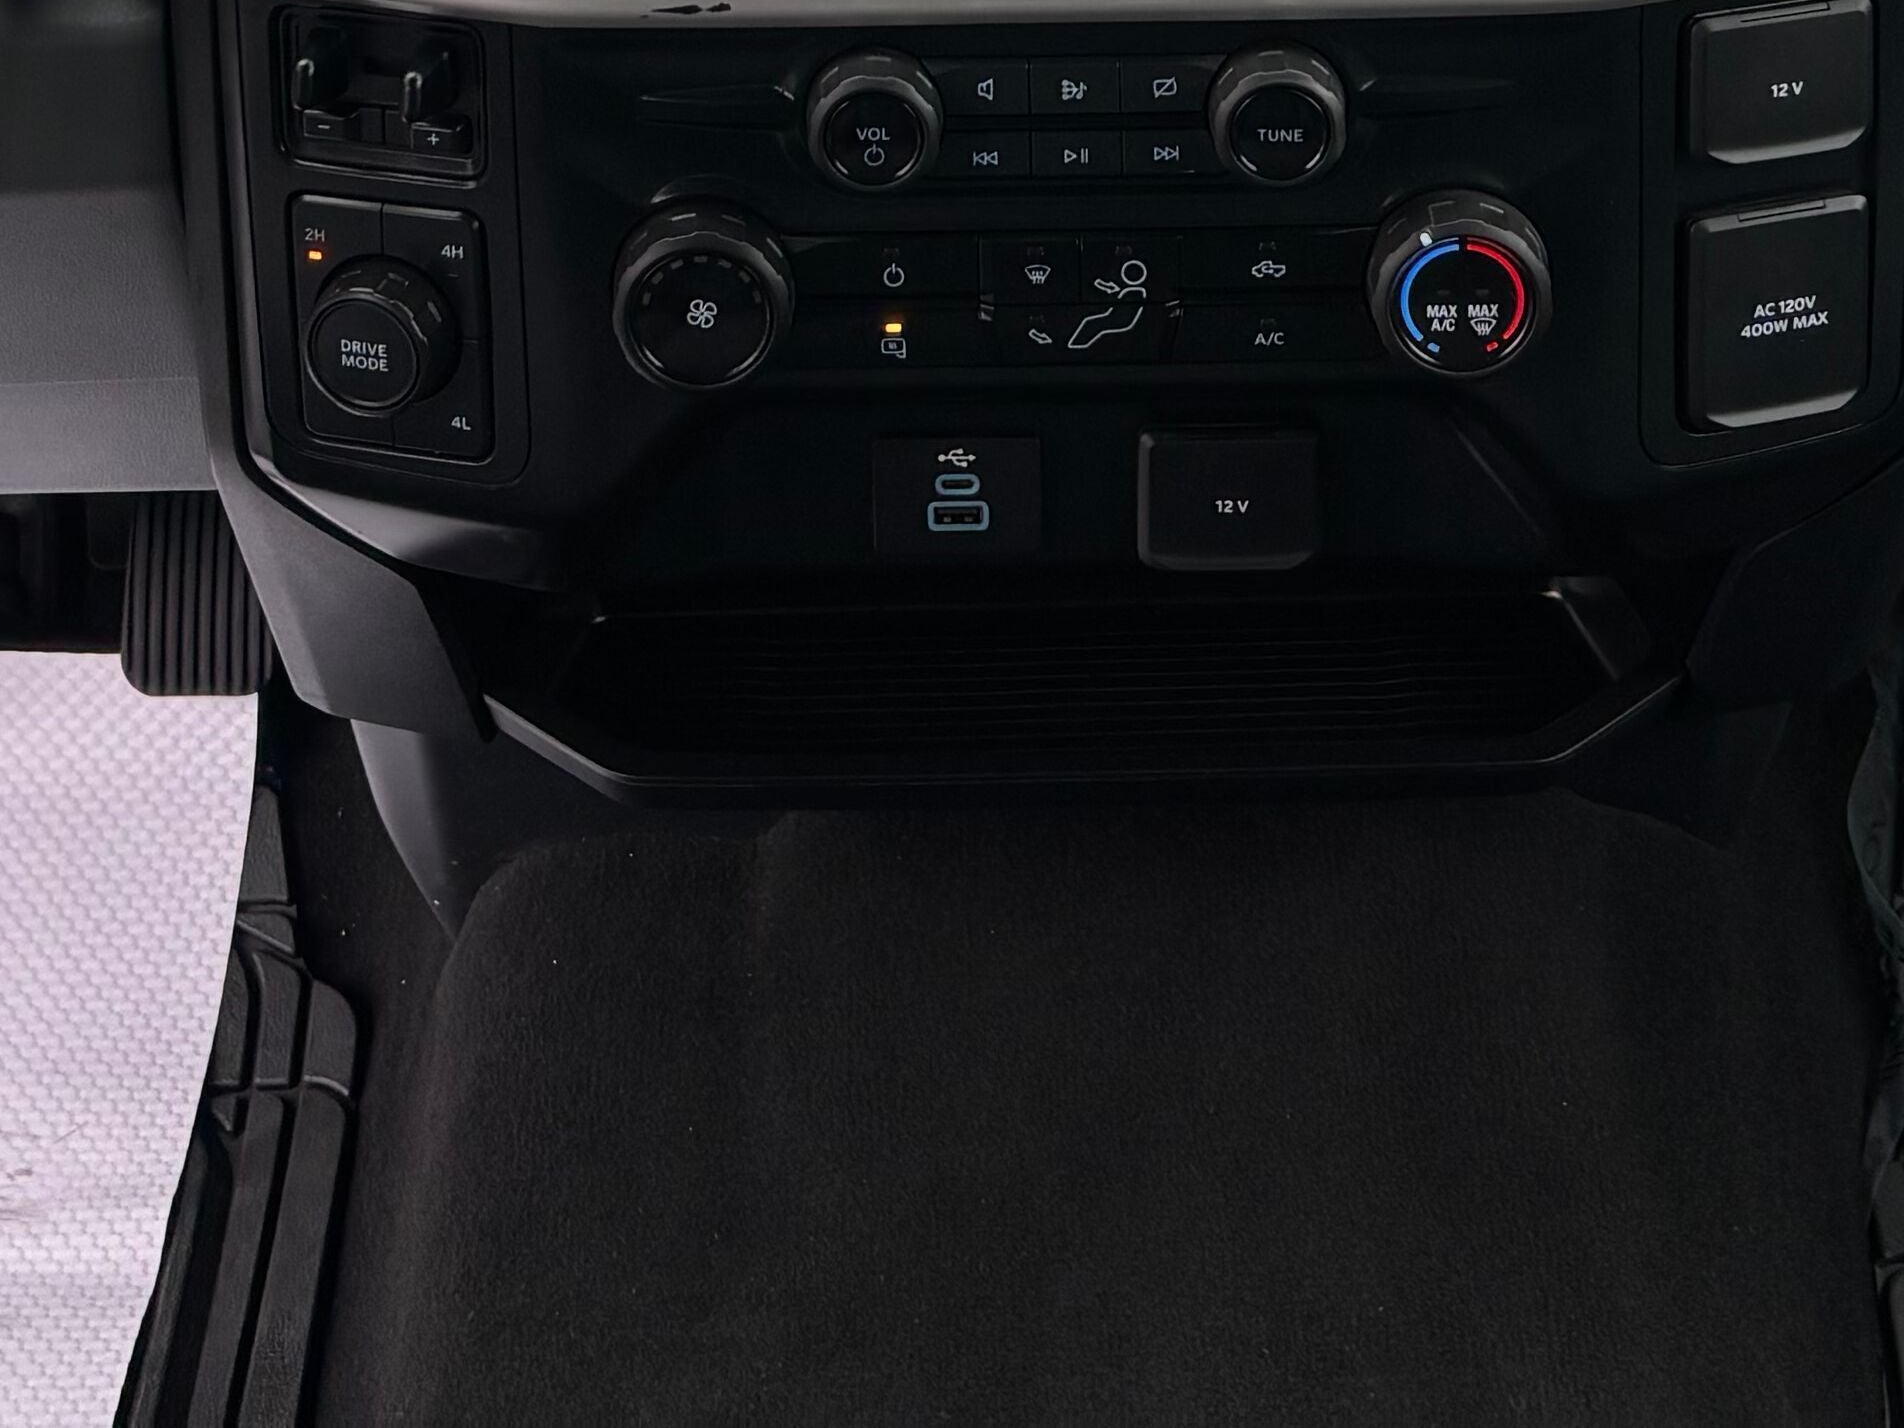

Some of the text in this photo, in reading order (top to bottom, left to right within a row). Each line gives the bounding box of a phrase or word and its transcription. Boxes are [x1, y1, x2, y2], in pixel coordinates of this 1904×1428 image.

[1771, 81, 1804, 98] 12 V
[856, 127, 891, 141] VOL
[1257, 129, 1304, 142] TUNE
[304, 228, 325, 242] 2H
[441, 245, 464, 259] 4H
[1426, 304, 1458, 319] MAX
[1467, 304, 1499, 318] MAX
[1753, 295, 1817, 319] AC 120V
[1431, 318, 1456, 332] A/C
[1740, 311, 1829, 338] 400W MAX
[1254, 333, 1285, 346] A/C
[340, 339, 388, 357] DRIVE
[341, 354, 389, 372] MODE
[451, 416, 471, 430] 4L
[1215, 499, 1249, 514] 12 V
